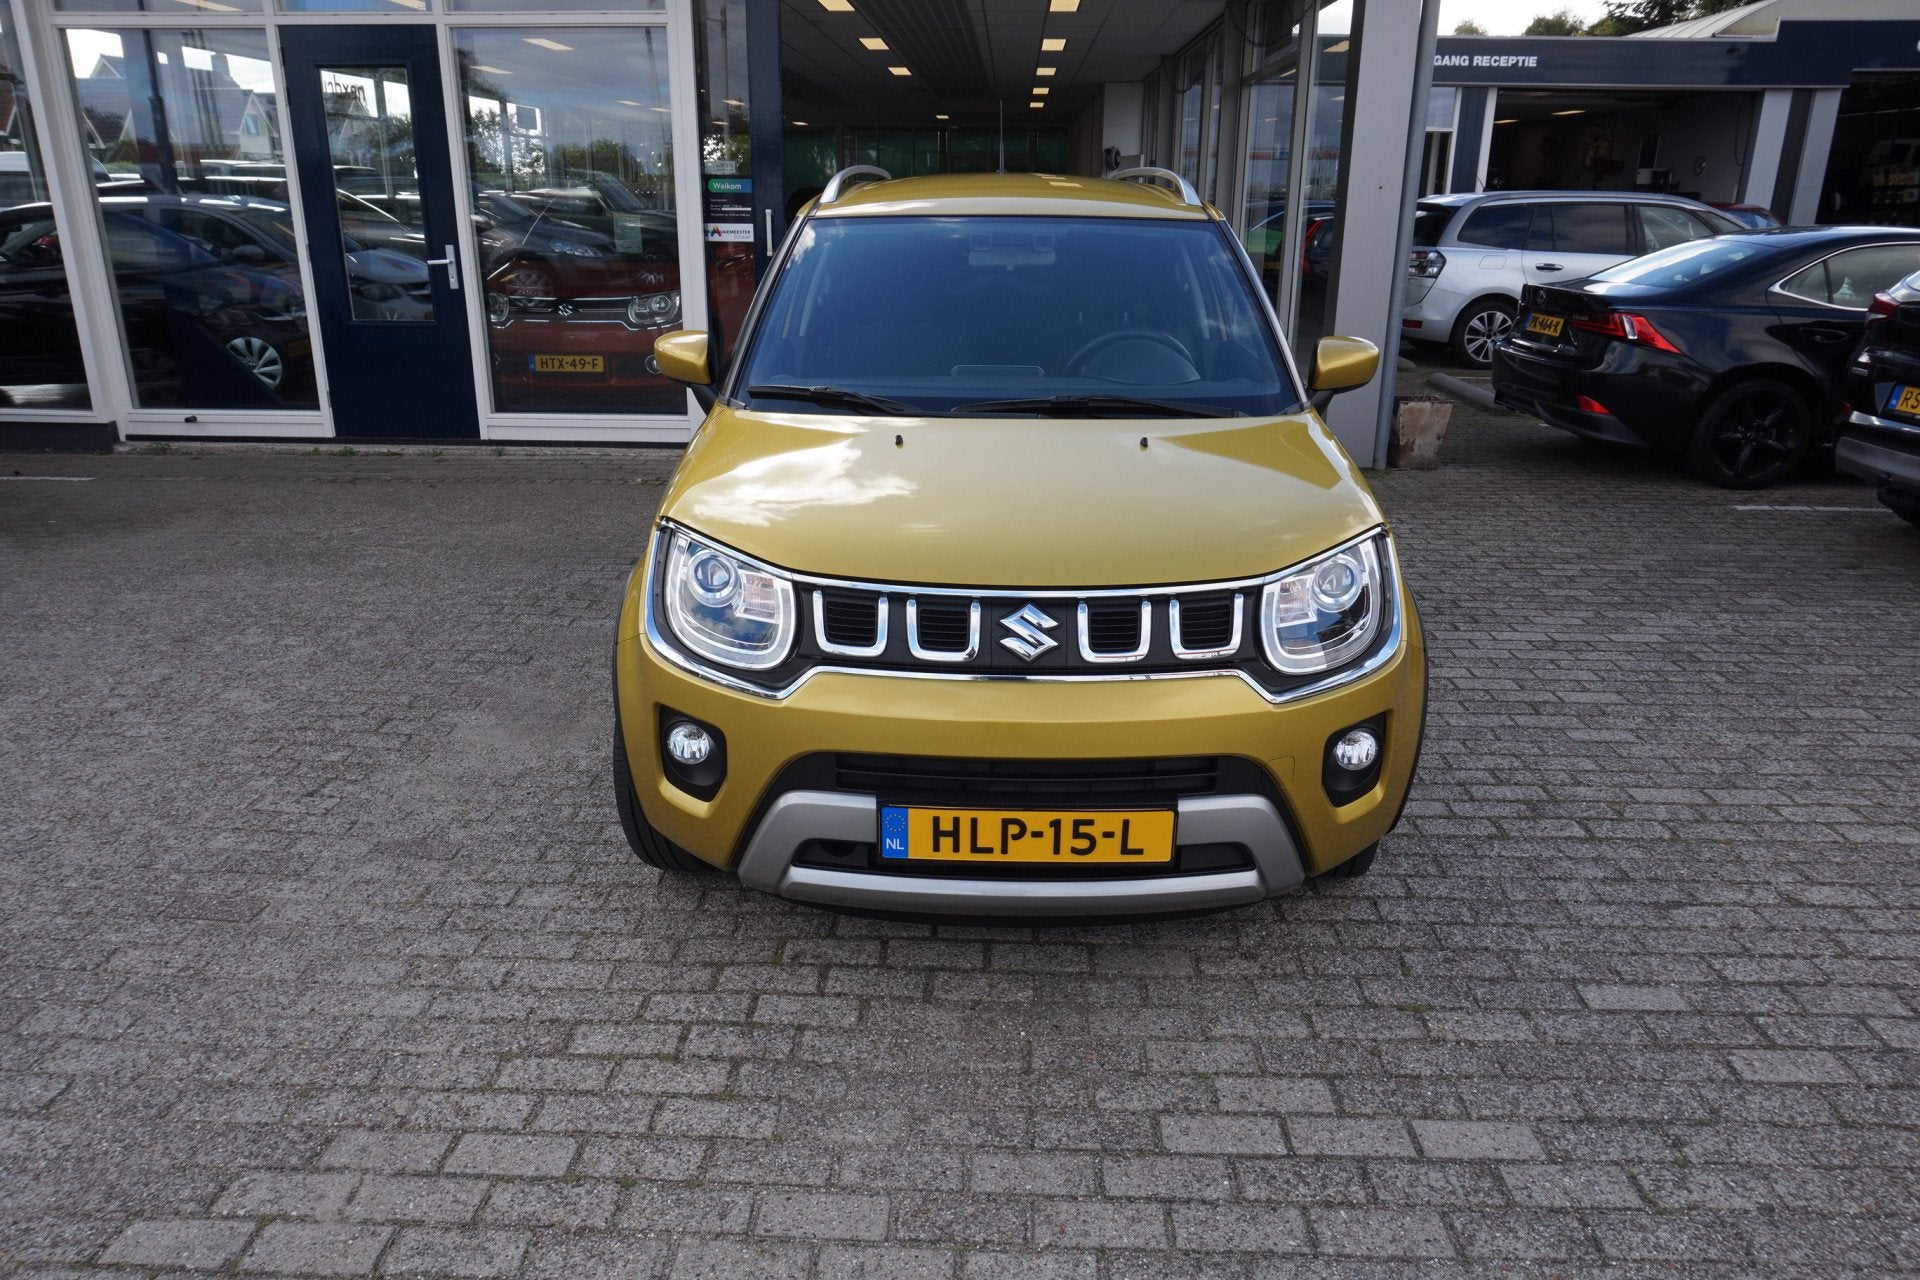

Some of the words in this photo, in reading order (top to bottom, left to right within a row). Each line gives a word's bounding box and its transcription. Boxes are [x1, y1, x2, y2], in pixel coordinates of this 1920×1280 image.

[1434, 55, 1469, 66] GANG
[1473, 55, 1538, 67] RECEPTIE
[713, 182, 742, 191] Welkom
[540, 358, 599, 370] HTX-49-F
[886, 838, 905, 850] NL
[932, 815, 1145, 857] HLP-15-L
